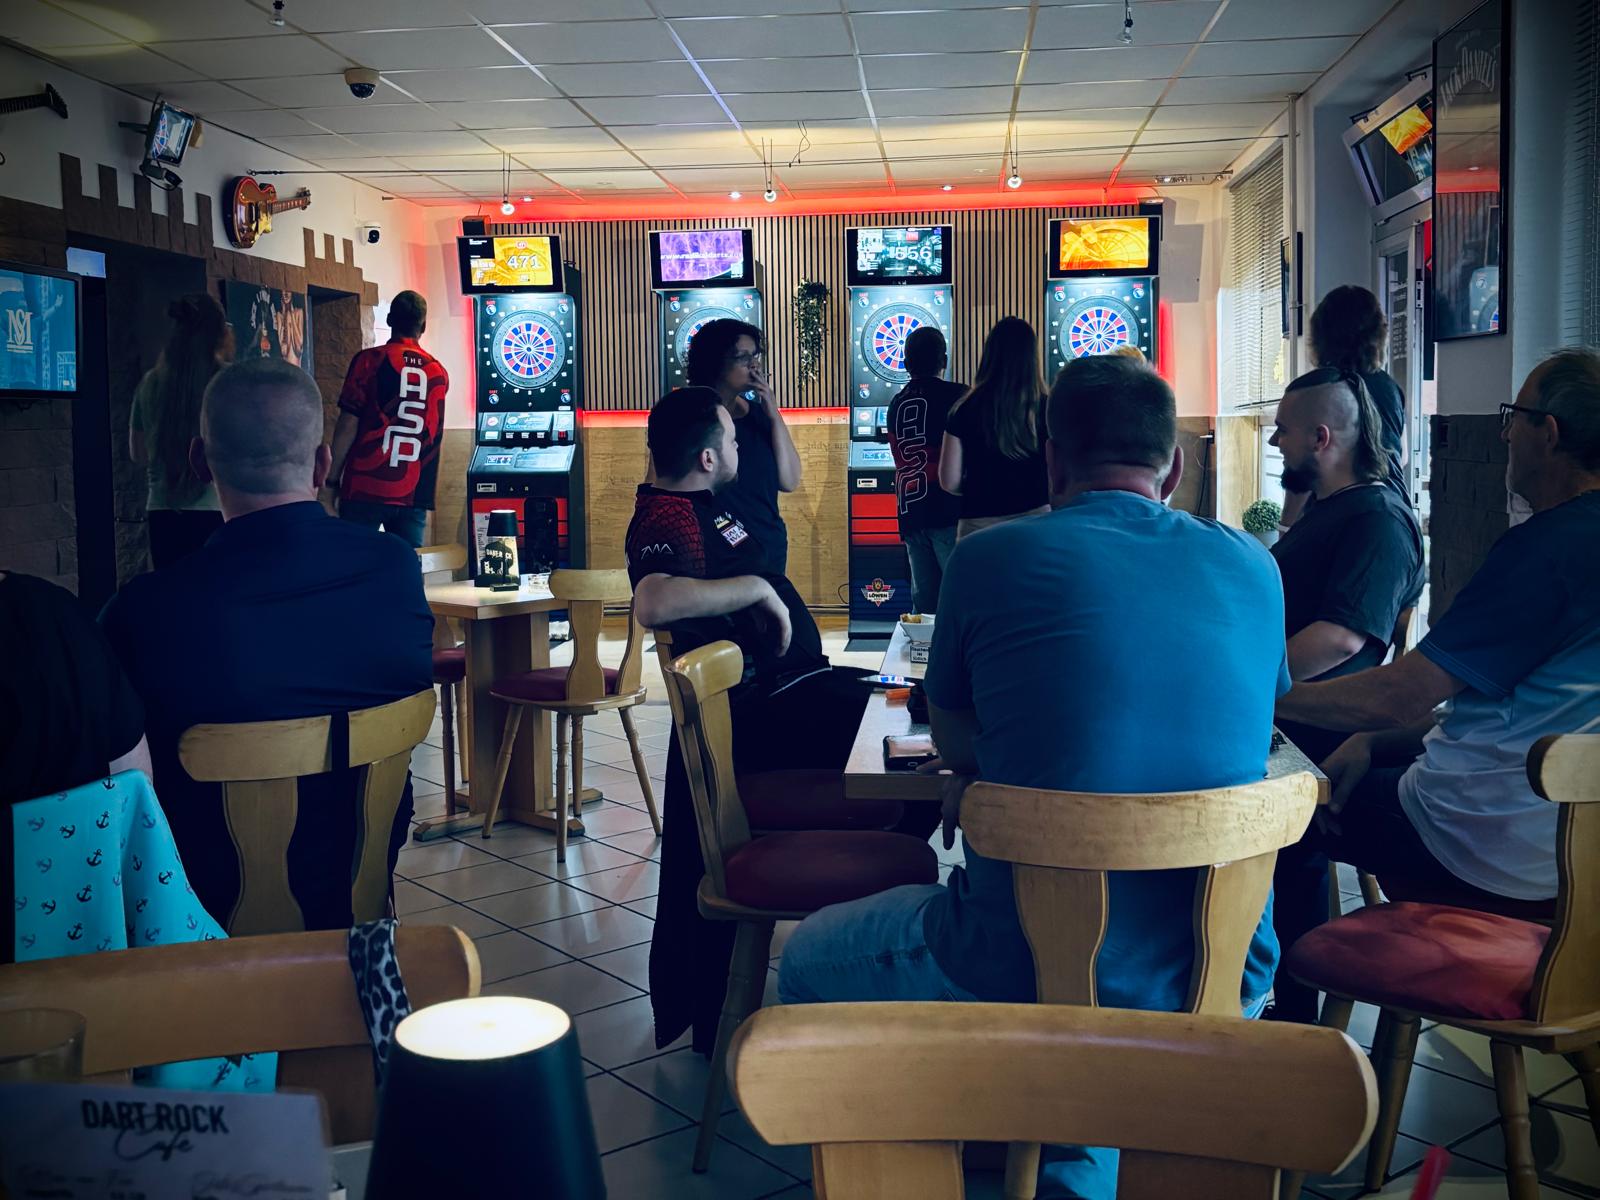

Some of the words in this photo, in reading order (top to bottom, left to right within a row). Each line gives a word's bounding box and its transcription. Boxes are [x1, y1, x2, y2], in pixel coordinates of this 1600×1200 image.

[507, 255, 540, 269] 471
[403, 356, 423, 366] THE
[382, 366, 428, 468] ASP
[896, 398, 928, 515] ASP
[82, 1099, 147, 1129] DART
[154, 1103, 230, 1134] ROCK
